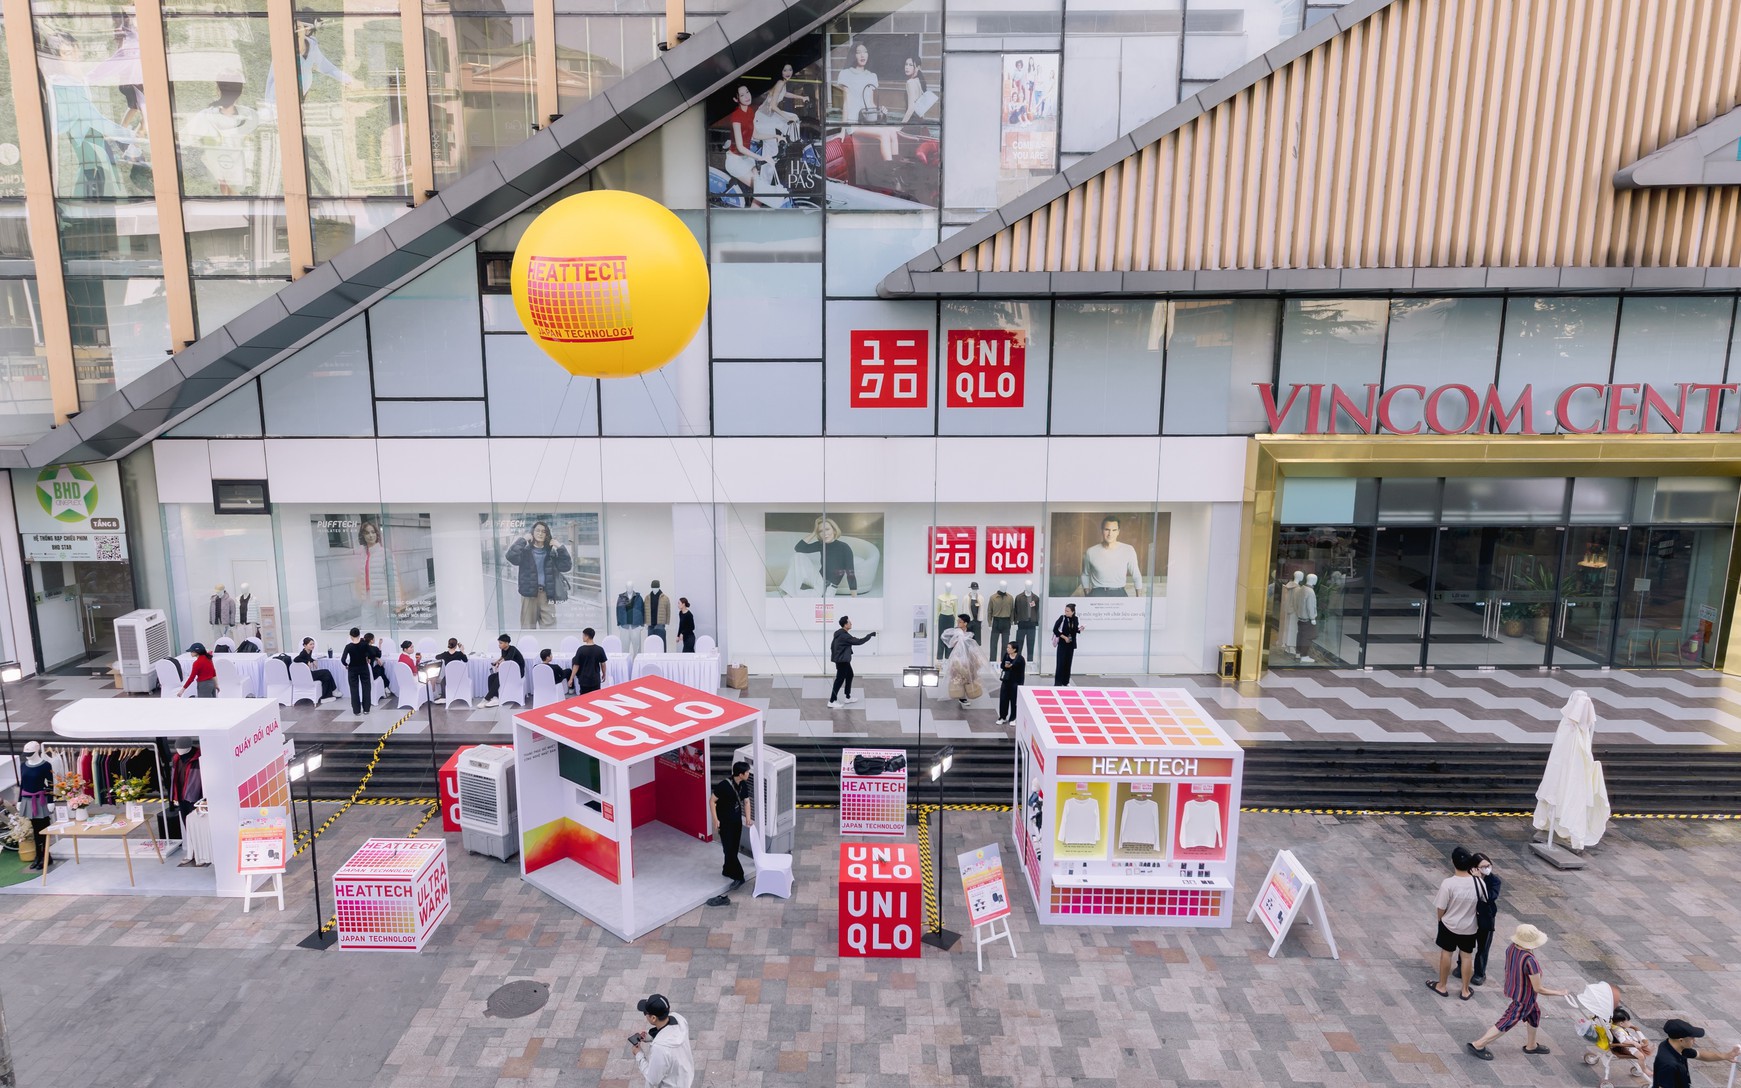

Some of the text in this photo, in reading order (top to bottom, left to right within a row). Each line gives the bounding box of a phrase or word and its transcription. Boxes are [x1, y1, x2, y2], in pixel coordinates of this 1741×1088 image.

[790, 161, 812, 176] HA
[788, 174, 815, 189] PAS
[527, 261, 627, 282] HEATTECH
[538, 327, 634, 338] JAPAN TECHNOLOGY
[956, 339, 1011, 367] UNI
[955, 371, 1016, 403] QLO
[1251, 382, 1741, 434] VINCOM CENT
[53, 481, 81, 500] BHD
[317, 520, 358, 528] PUFFTECH
[485, 520, 526, 528] PFFTECH
[992, 532, 1026, 549] UNI
[991, 551, 1029, 571] QLO
[544, 686, 676, 728] UNI
[595, 701, 725, 747] QLO
[1092, 757, 1199, 776] HEATTECH
[841, 781, 906, 793] HEATTECH
[363, 842, 441, 850] HEATTECH
[847, 846, 905, 862] UNI
[847, 863, 913, 881] QLO
[335, 884, 413, 897] HEATTECH
[417, 861, 447, 907] ULTRA
[418, 878, 449, 927] WARM
[847, 890, 907, 918] UNI
[368, 935, 416, 943] TECHNOLOGY
[847, 922, 913, 954] QLO
